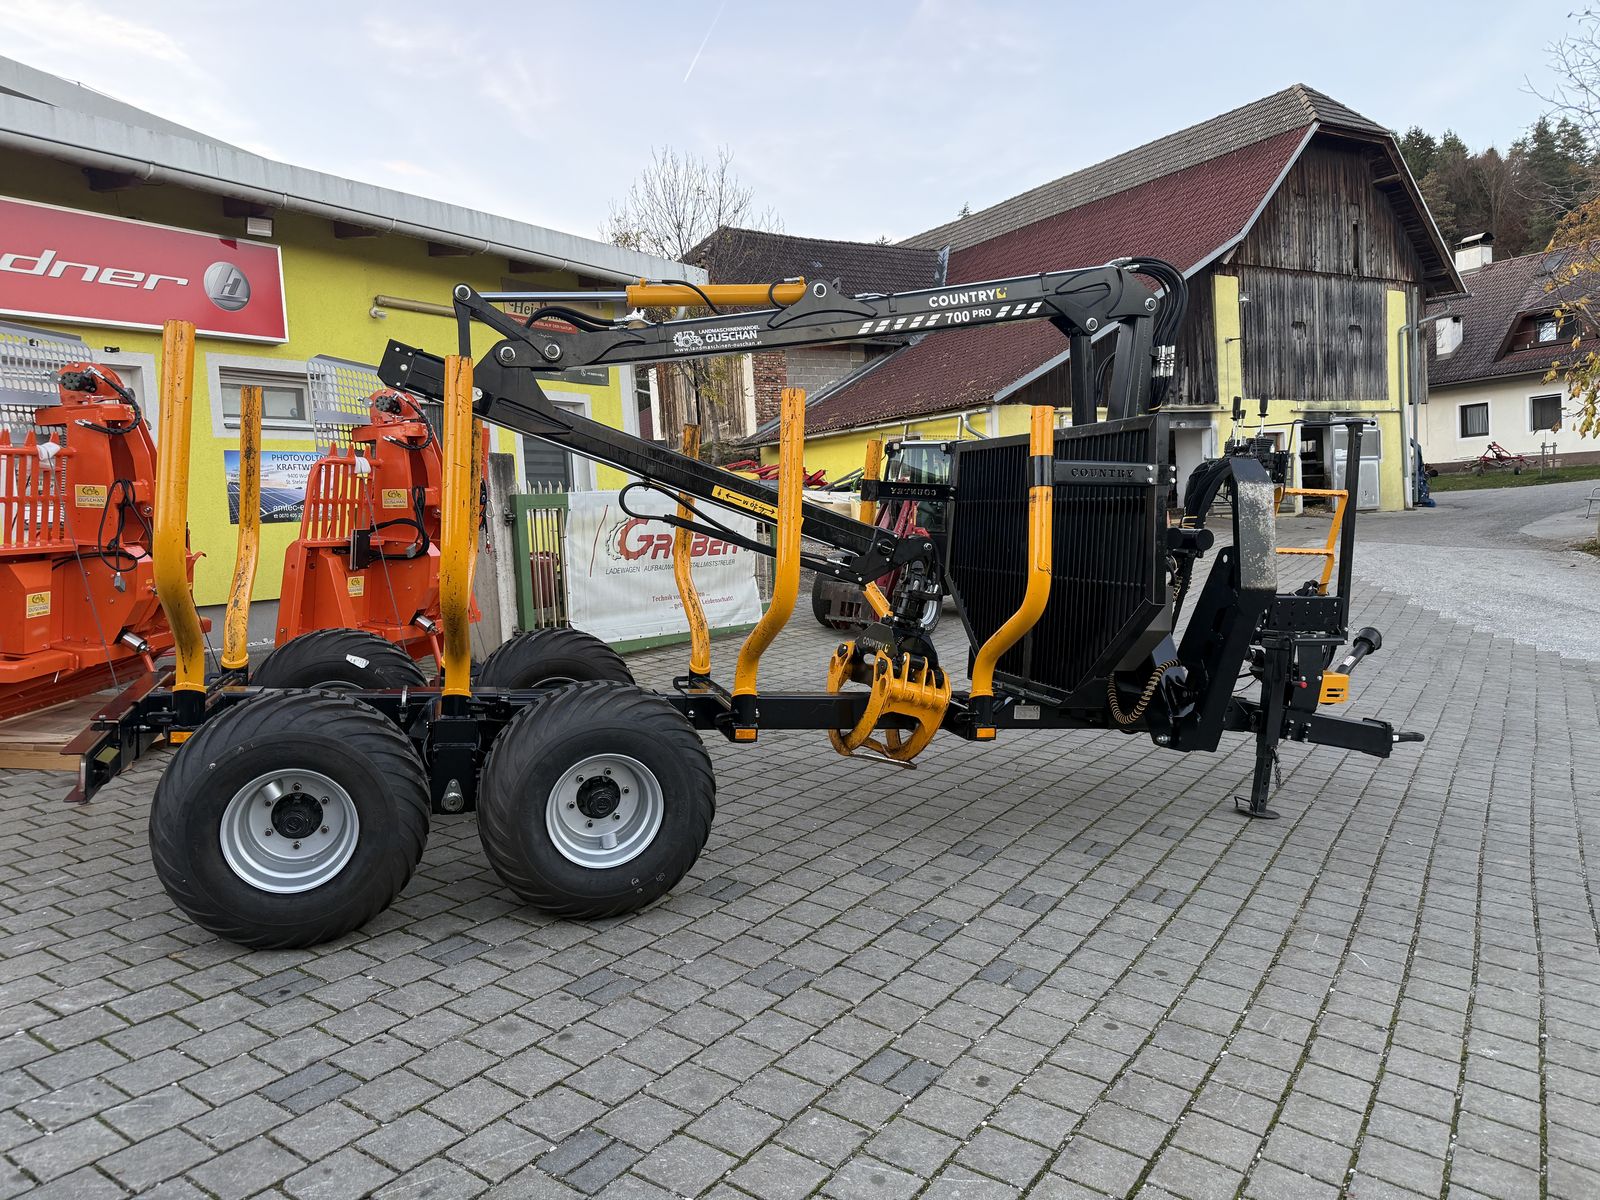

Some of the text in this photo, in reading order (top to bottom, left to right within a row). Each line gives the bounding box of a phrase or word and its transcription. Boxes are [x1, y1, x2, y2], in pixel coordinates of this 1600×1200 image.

[929, 289, 996, 308] COUNTRY
[945, 308, 992, 325] 700 PRO
[698, 325, 760, 335] LANDMASCHINENHANDEL
[1071, 468, 1135, 479] COUNTRY
[618, 517, 738, 560] GRBER
[605, 566, 641, 575] LADEWAGEN
[652, 594, 673, 603] Technik
